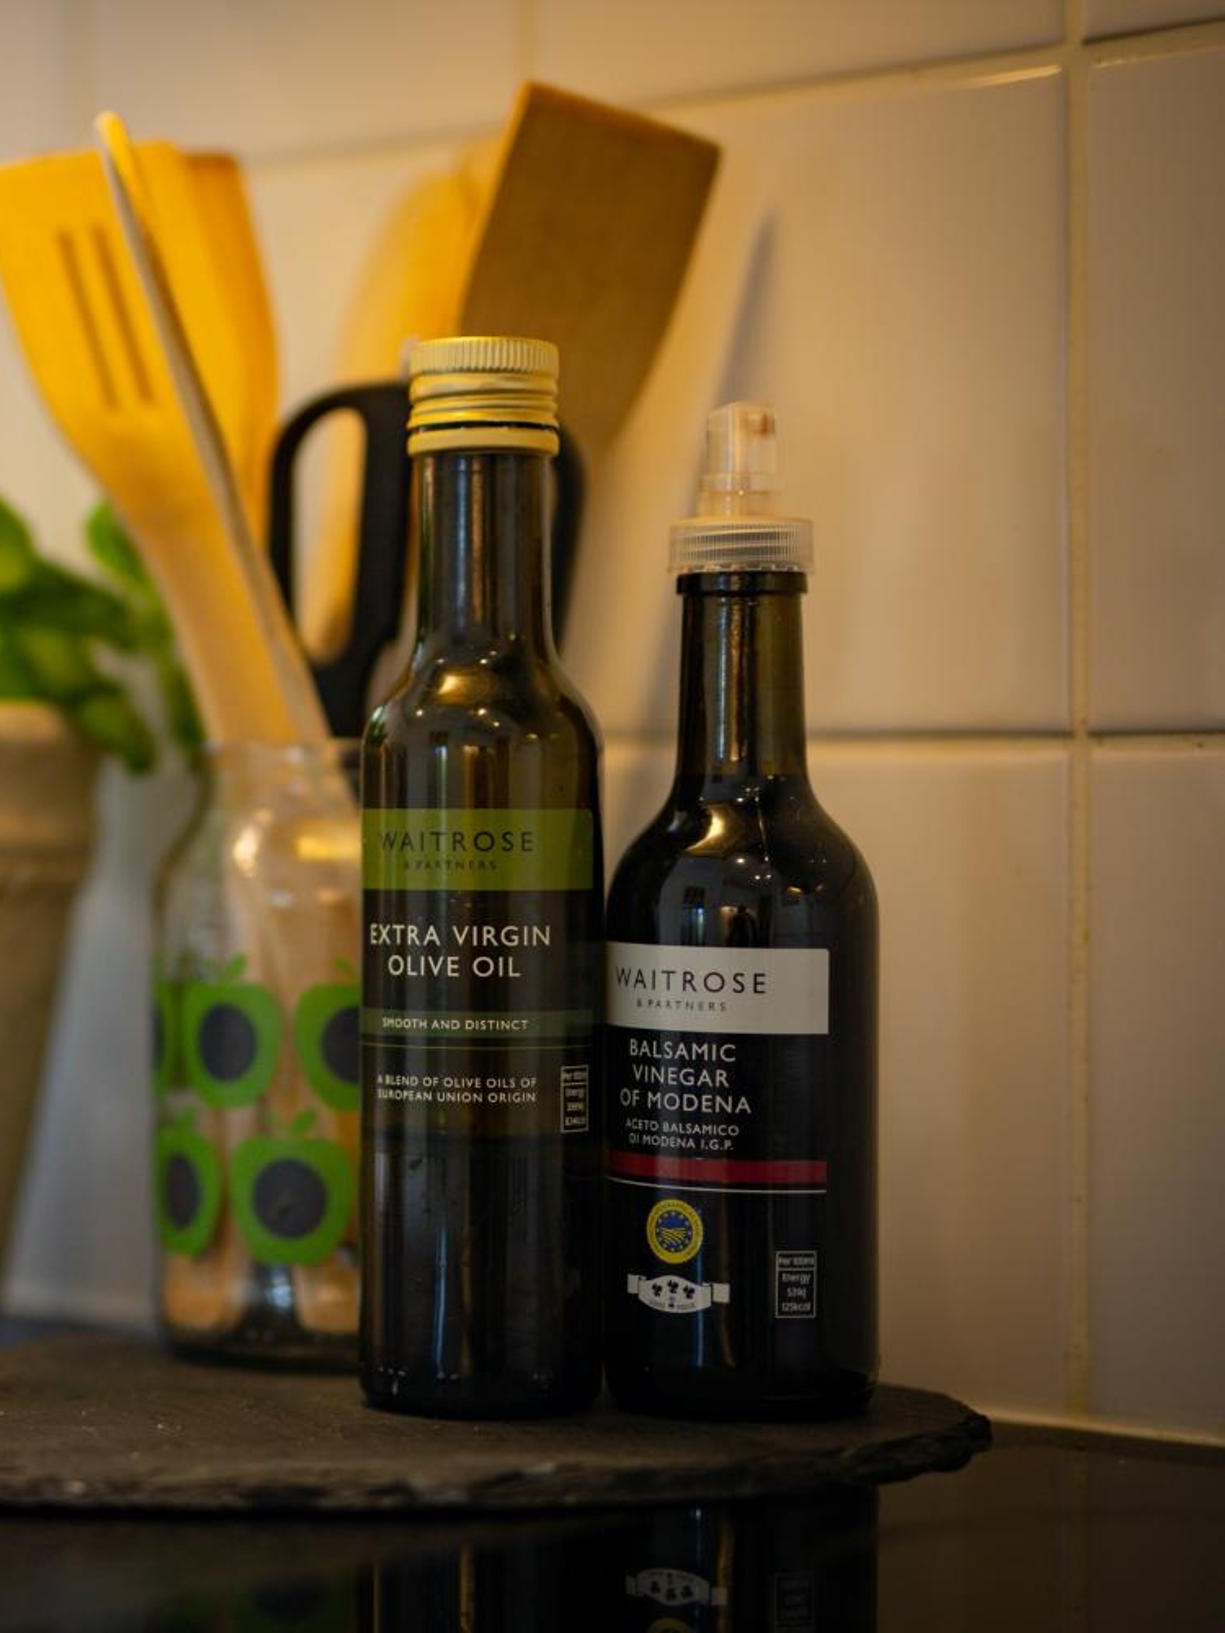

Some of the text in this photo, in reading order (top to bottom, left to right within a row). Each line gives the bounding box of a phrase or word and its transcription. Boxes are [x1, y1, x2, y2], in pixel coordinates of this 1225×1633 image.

[381, 831, 534, 852] WAITROSE
[414, 860, 498, 872] PARTNERS
[370, 923, 551, 947] EXTRA VIRGIN
[388, 955, 522, 978] OLIVE OIL
[615, 966, 767, 994] WAITROSE
[648, 1000, 727, 1012] PARTNERS
[382, 1017, 528, 1031] SMOOTH AND DISTINCT
[629, 1038, 736, 1062] BALSAMIC
[377, 1074, 537, 1089] A BLEND OF OLIVE OILS OF
[632, 1064, 729, 1088] VINEGAR
[377, 1089, 536, 1103] EUROPEAN UNION ORIGIN
[620, 1088, 752, 1114] OF MODENA
[626, 1118, 739, 1136] ACETO BALSAMICO
[643, 1134, 696, 1149] MODENA
[700, 1138, 734, 1151] I.G.P.
